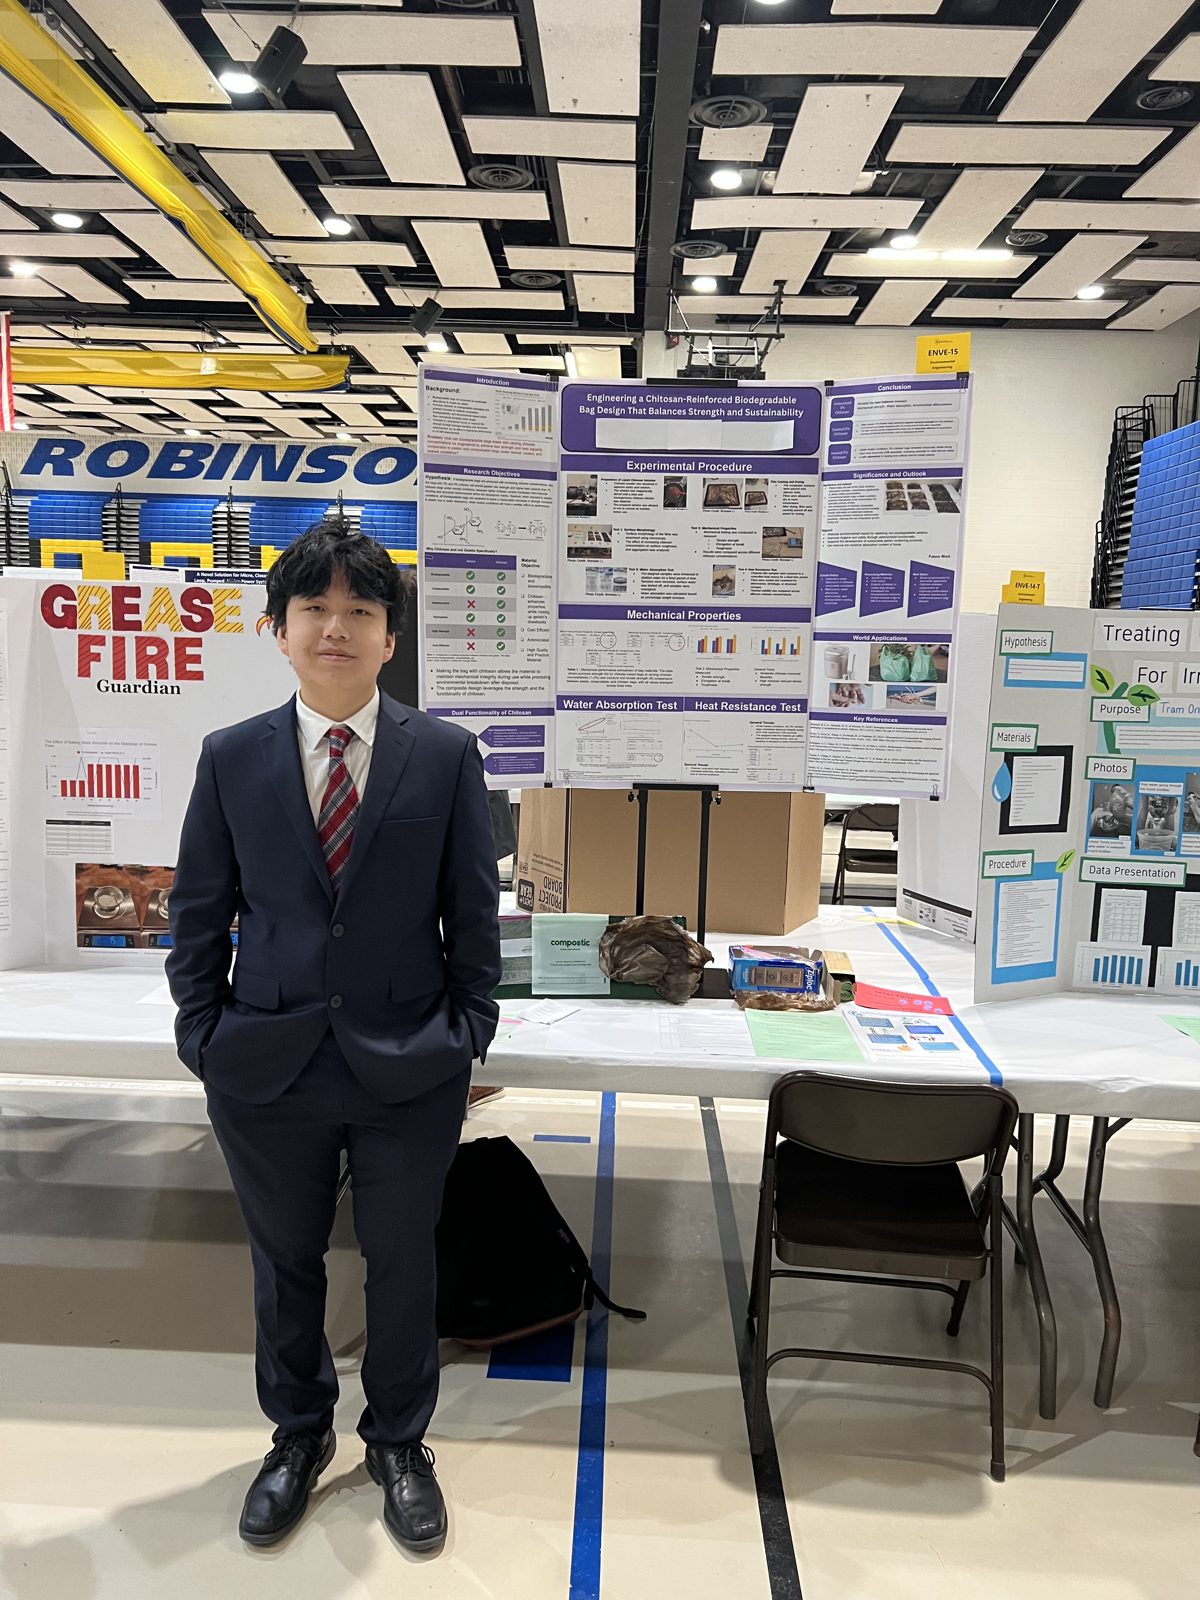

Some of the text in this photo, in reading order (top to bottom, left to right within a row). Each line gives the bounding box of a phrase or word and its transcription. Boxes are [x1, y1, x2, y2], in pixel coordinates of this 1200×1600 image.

[928, 348, 959, 357] ENVE-15
[476, 376, 510, 387] Introduction
[877, 384, 912, 392] Conclusion
[587, 393, 637, 404] Engineering
[645, 395, 733, 404] Chitosan-Reinforced
[735, 396, 797, 406] Biodegradable
[579, 406, 804, 418] Bag Design That Balances Strength and Sustainability
[20, 437, 418, 486] ROBINSO
[626, 461, 753, 472] Experimental Procedure
[463, 468, 521, 478] Research Objectives
[853, 472, 889, 480] Significance
[902, 470, 927, 478] Outlook
[41, 583, 243, 633] GREASE
[627, 610, 742, 622] Mechanical Properties
[1103, 624, 1180, 647] Treating
[1004, 637, 1047, 648] Hypothesis
[77, 633, 204, 681] FIRE
[1137, 666, 1167, 683] For
[96, 679, 182, 695] Guardian
[563, 699, 678, 712] Water Absorption Test
[695, 701, 801, 712] Heat Resistance Test
[1100, 703, 1141, 716] Purpose
[465, 709, 501, 717] Functionality
[853, 715, 864, 723] Key
[996, 732, 1031, 743] Materials
[1093, 762, 1127, 774] Photos
[988, 859, 1027, 870] Procedure
[1089, 865, 1176, 880] Data Presentation
[543, 875, 563, 895] BOARD
[538, 888, 562, 910] PROJECT
[550, 938, 591, 948] compostic
[804, 968, 815, 990] Ziploc
